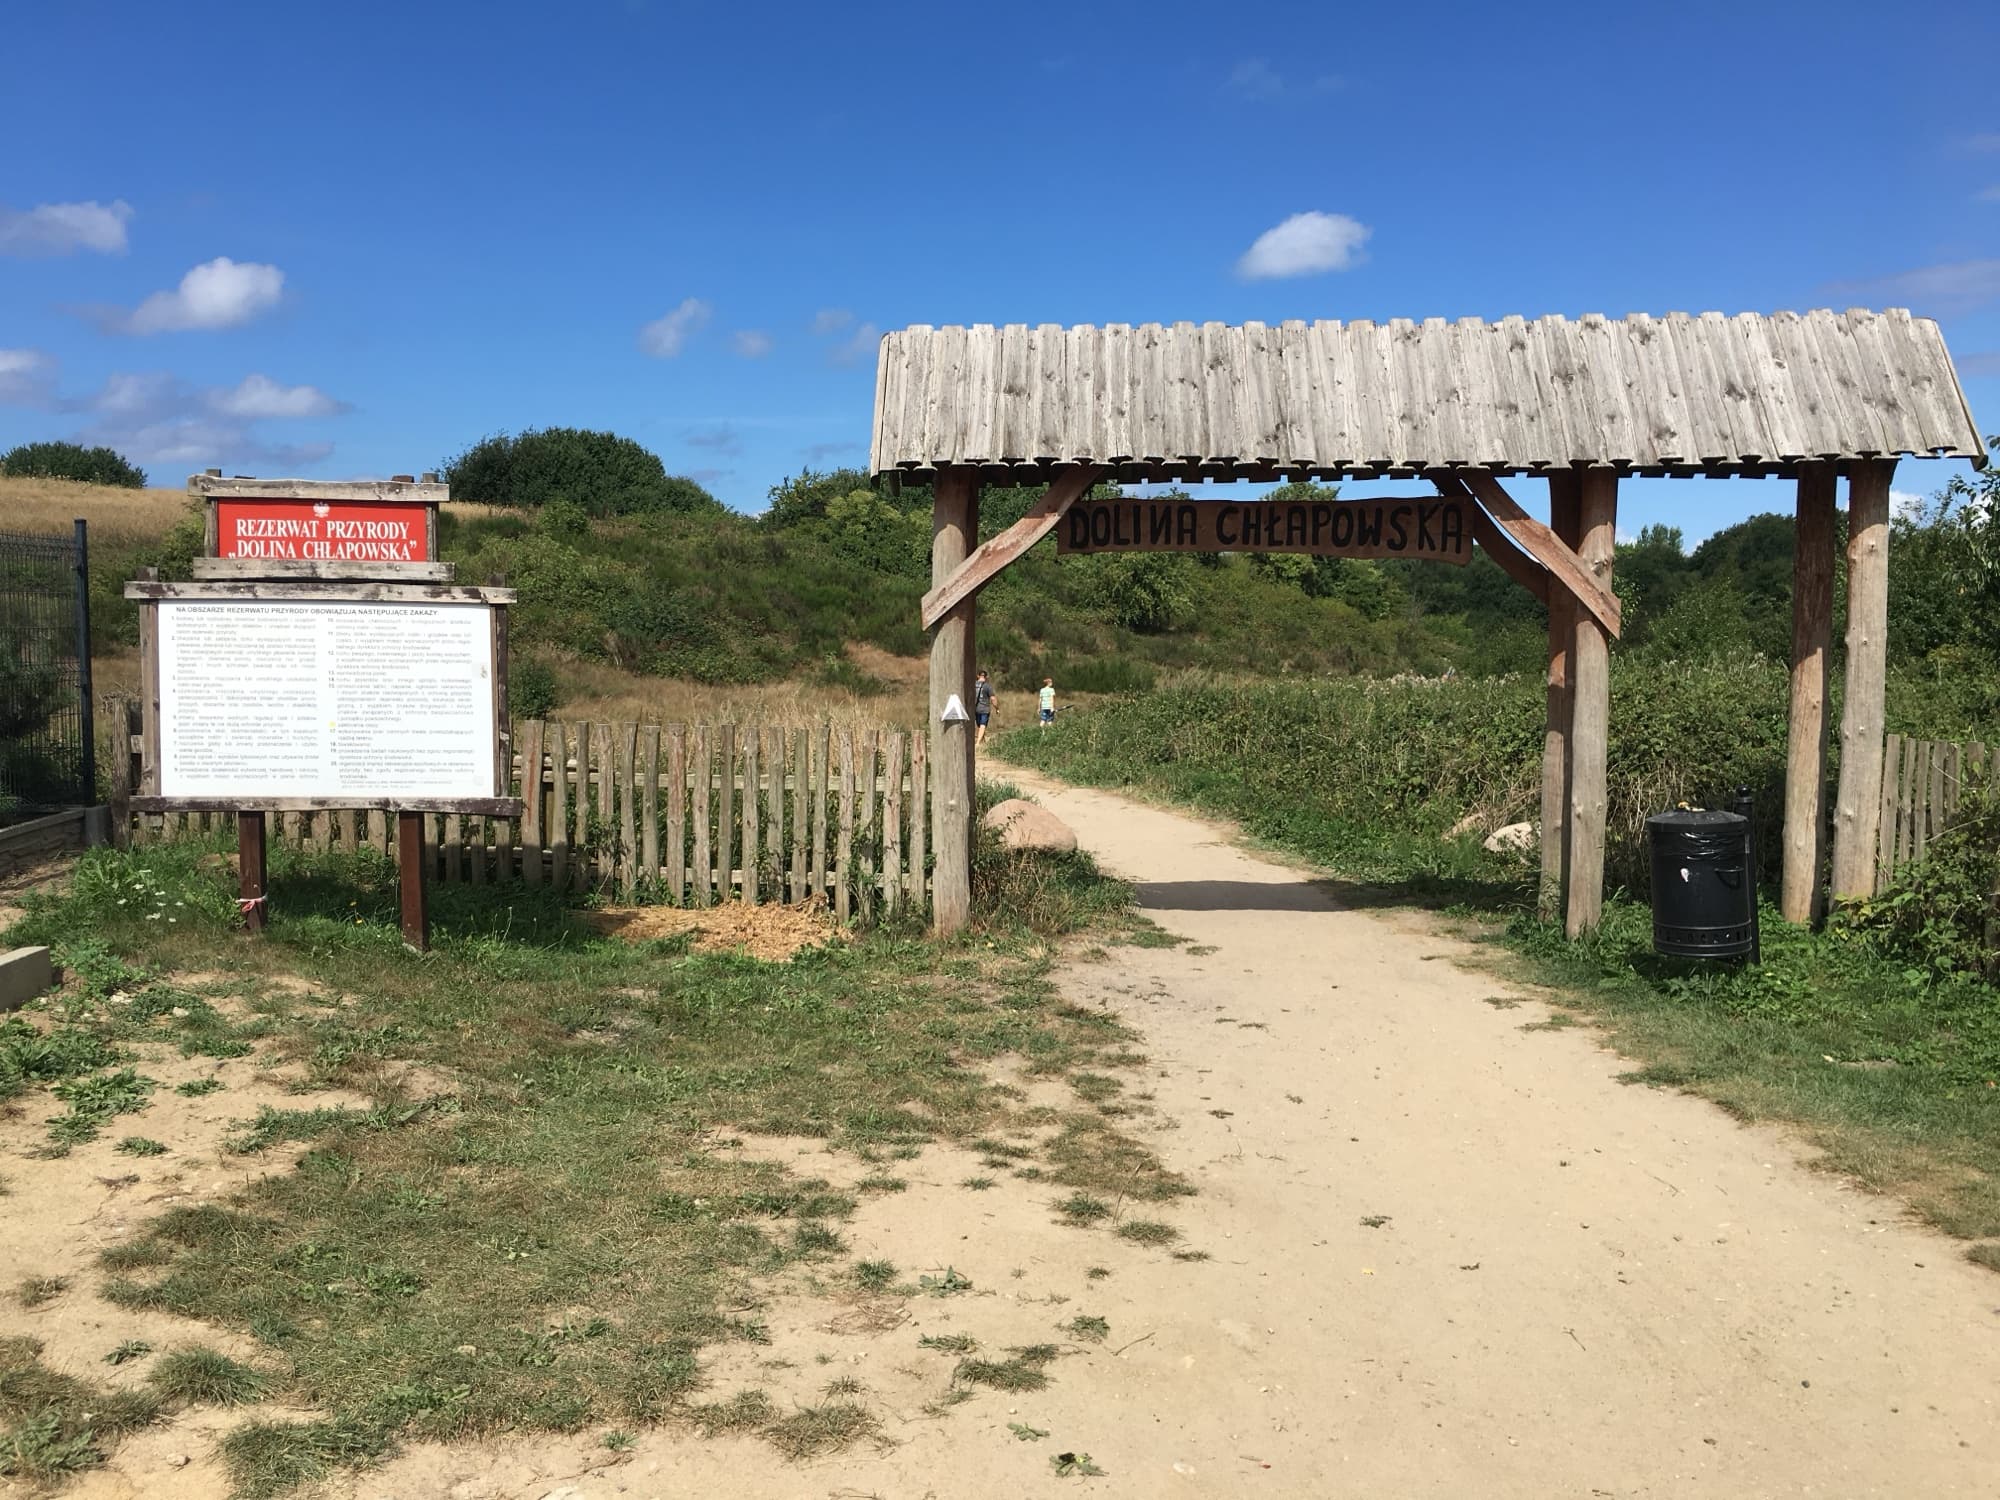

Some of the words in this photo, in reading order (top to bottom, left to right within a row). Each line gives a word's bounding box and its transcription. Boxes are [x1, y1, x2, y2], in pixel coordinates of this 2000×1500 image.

[236, 519, 319, 538] REZERWAT
[327, 520, 410, 539] PRZYRODY
[1216, 503, 1462, 554] CHŁAPOWSKA
